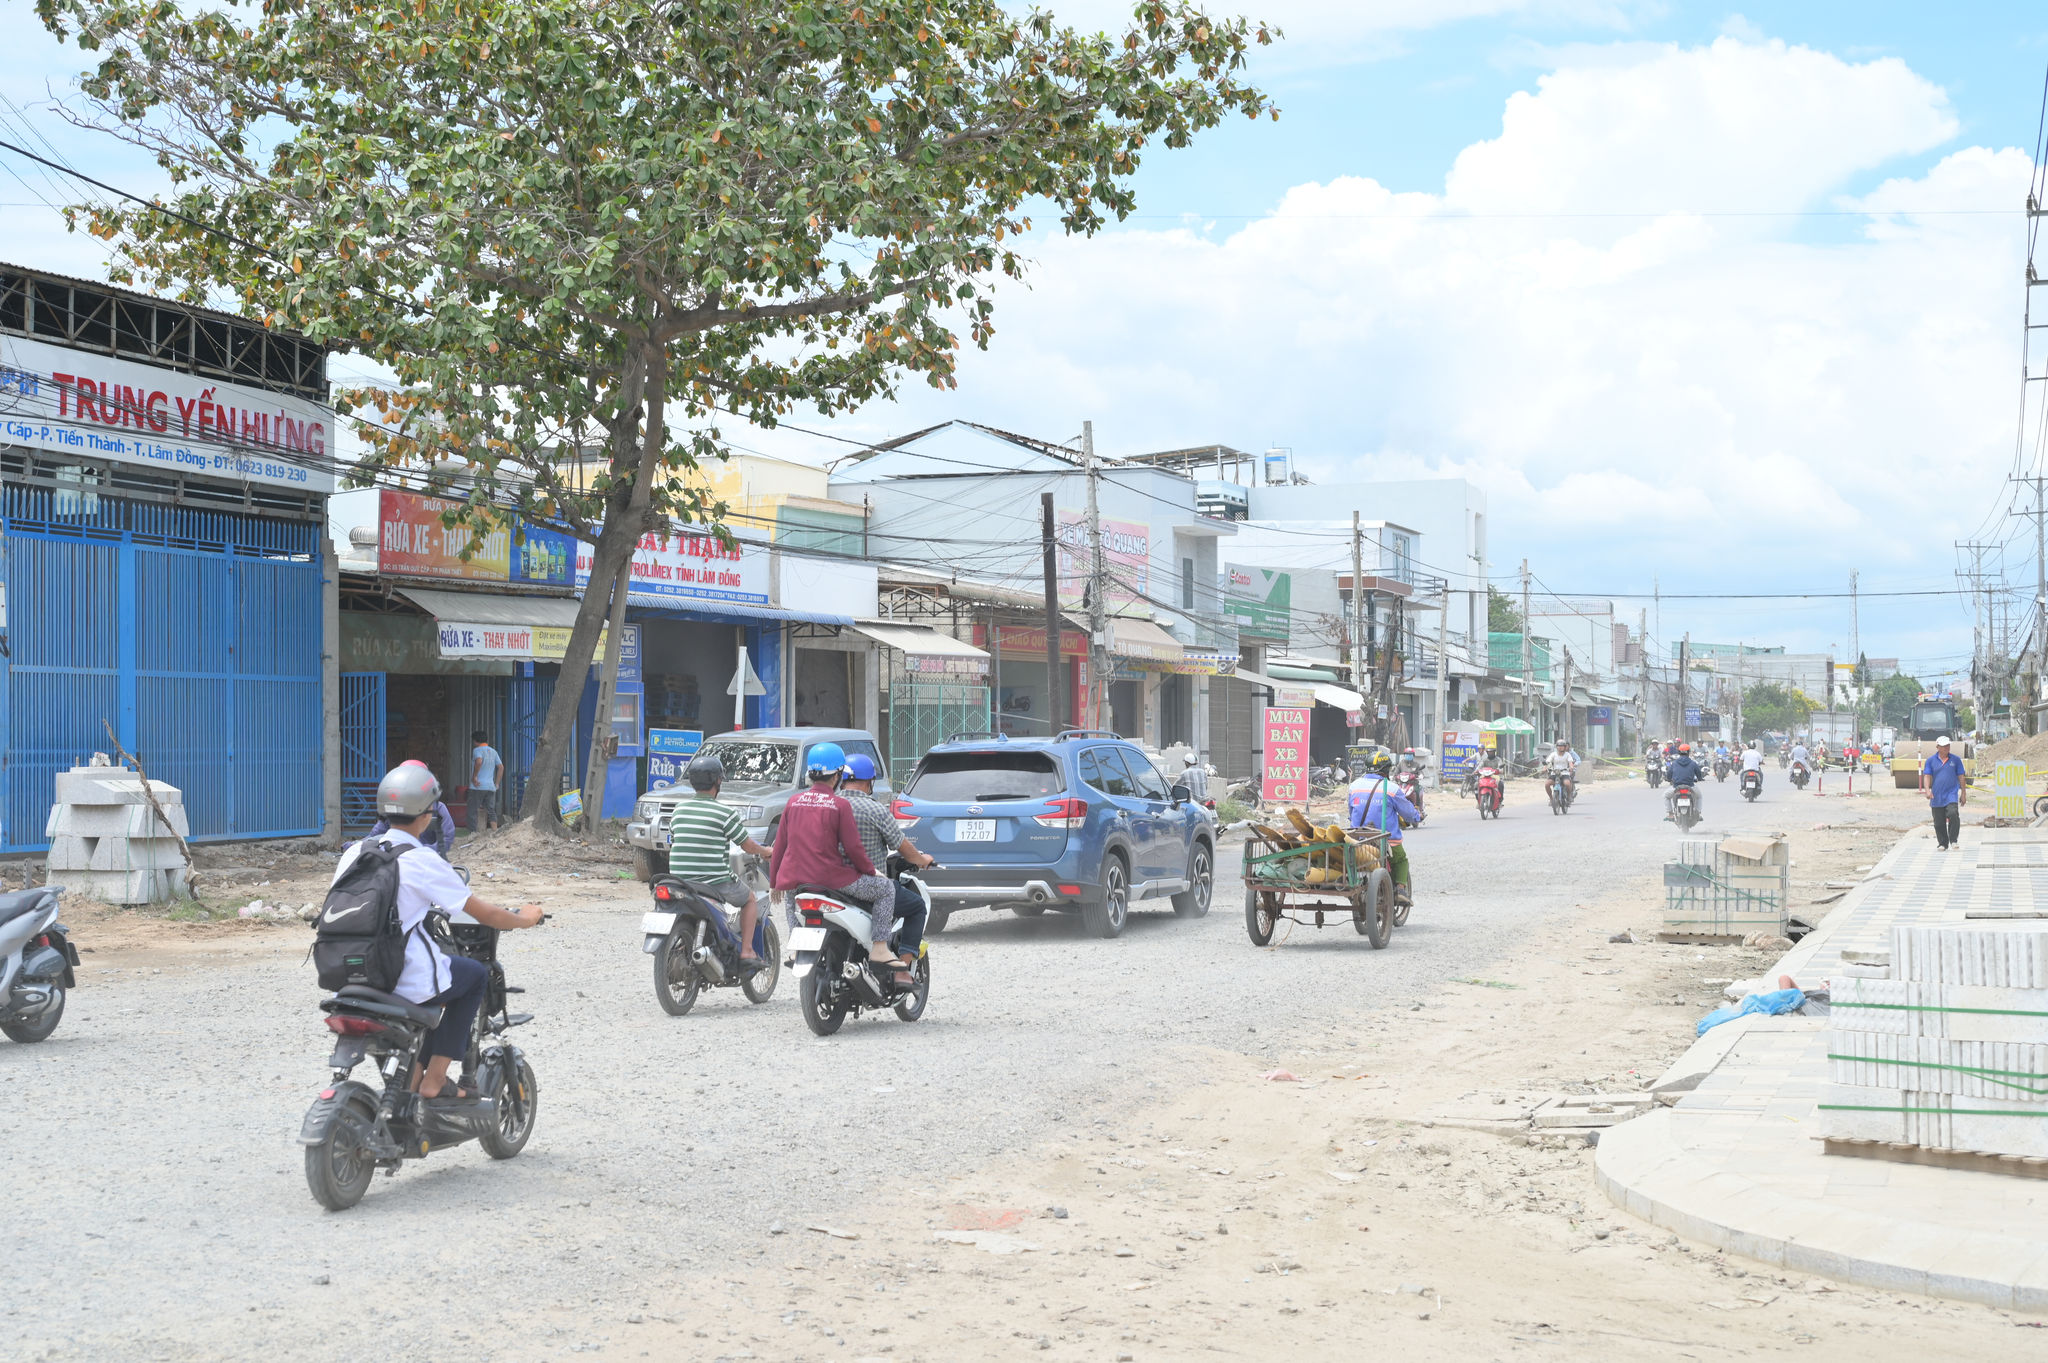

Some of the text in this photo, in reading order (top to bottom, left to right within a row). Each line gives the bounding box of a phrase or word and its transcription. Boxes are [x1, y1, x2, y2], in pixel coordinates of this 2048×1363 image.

[52, 371, 168, 433] TRUNG
[175, 386, 236, 443] YẾN
[241, 409, 325, 456] HƯNG
[56, 428, 84, 447] Tiến
[87, 434, 125, 454] Thành
[134, 443, 146, 457] T.
[148, 445, 173, 461] Lâm
[175, 448, 206, 469] Đồng
[265, 464, 285, 479] 819
[287, 467, 307, 482] 230
[383, 508, 410, 554] RỬA
[413, 523, 430, 555] XE
[1113, 532, 1147, 557] QUANG
[629, 562, 673, 580] TROLIMEX
[697, 567, 716, 585] LÂM
[440, 624, 459, 648] RỬA
[461, 630, 474, 648] XE
[483, 631, 505, 649] THAY
[507, 629, 531, 650] NHỚT
[538, 631, 549, 641] Đặt
[411, 639, 437, 659] THA
[1128, 643, 1152, 657] QUANG
[1268, 709, 1306, 724] MUA
[663, 740, 700, 748] PETROLIMEX
[1444, 747, 1465, 757] HONDA
[1274, 748, 1298, 762] XE
[650, 756, 675, 777] Rửa
[1996, 763, 2025, 787] CƠM
[1274, 782, 1297, 799] CŨ
[1995, 794, 2025, 817] TRƯA
[960, 830, 991, 840] 172.07
